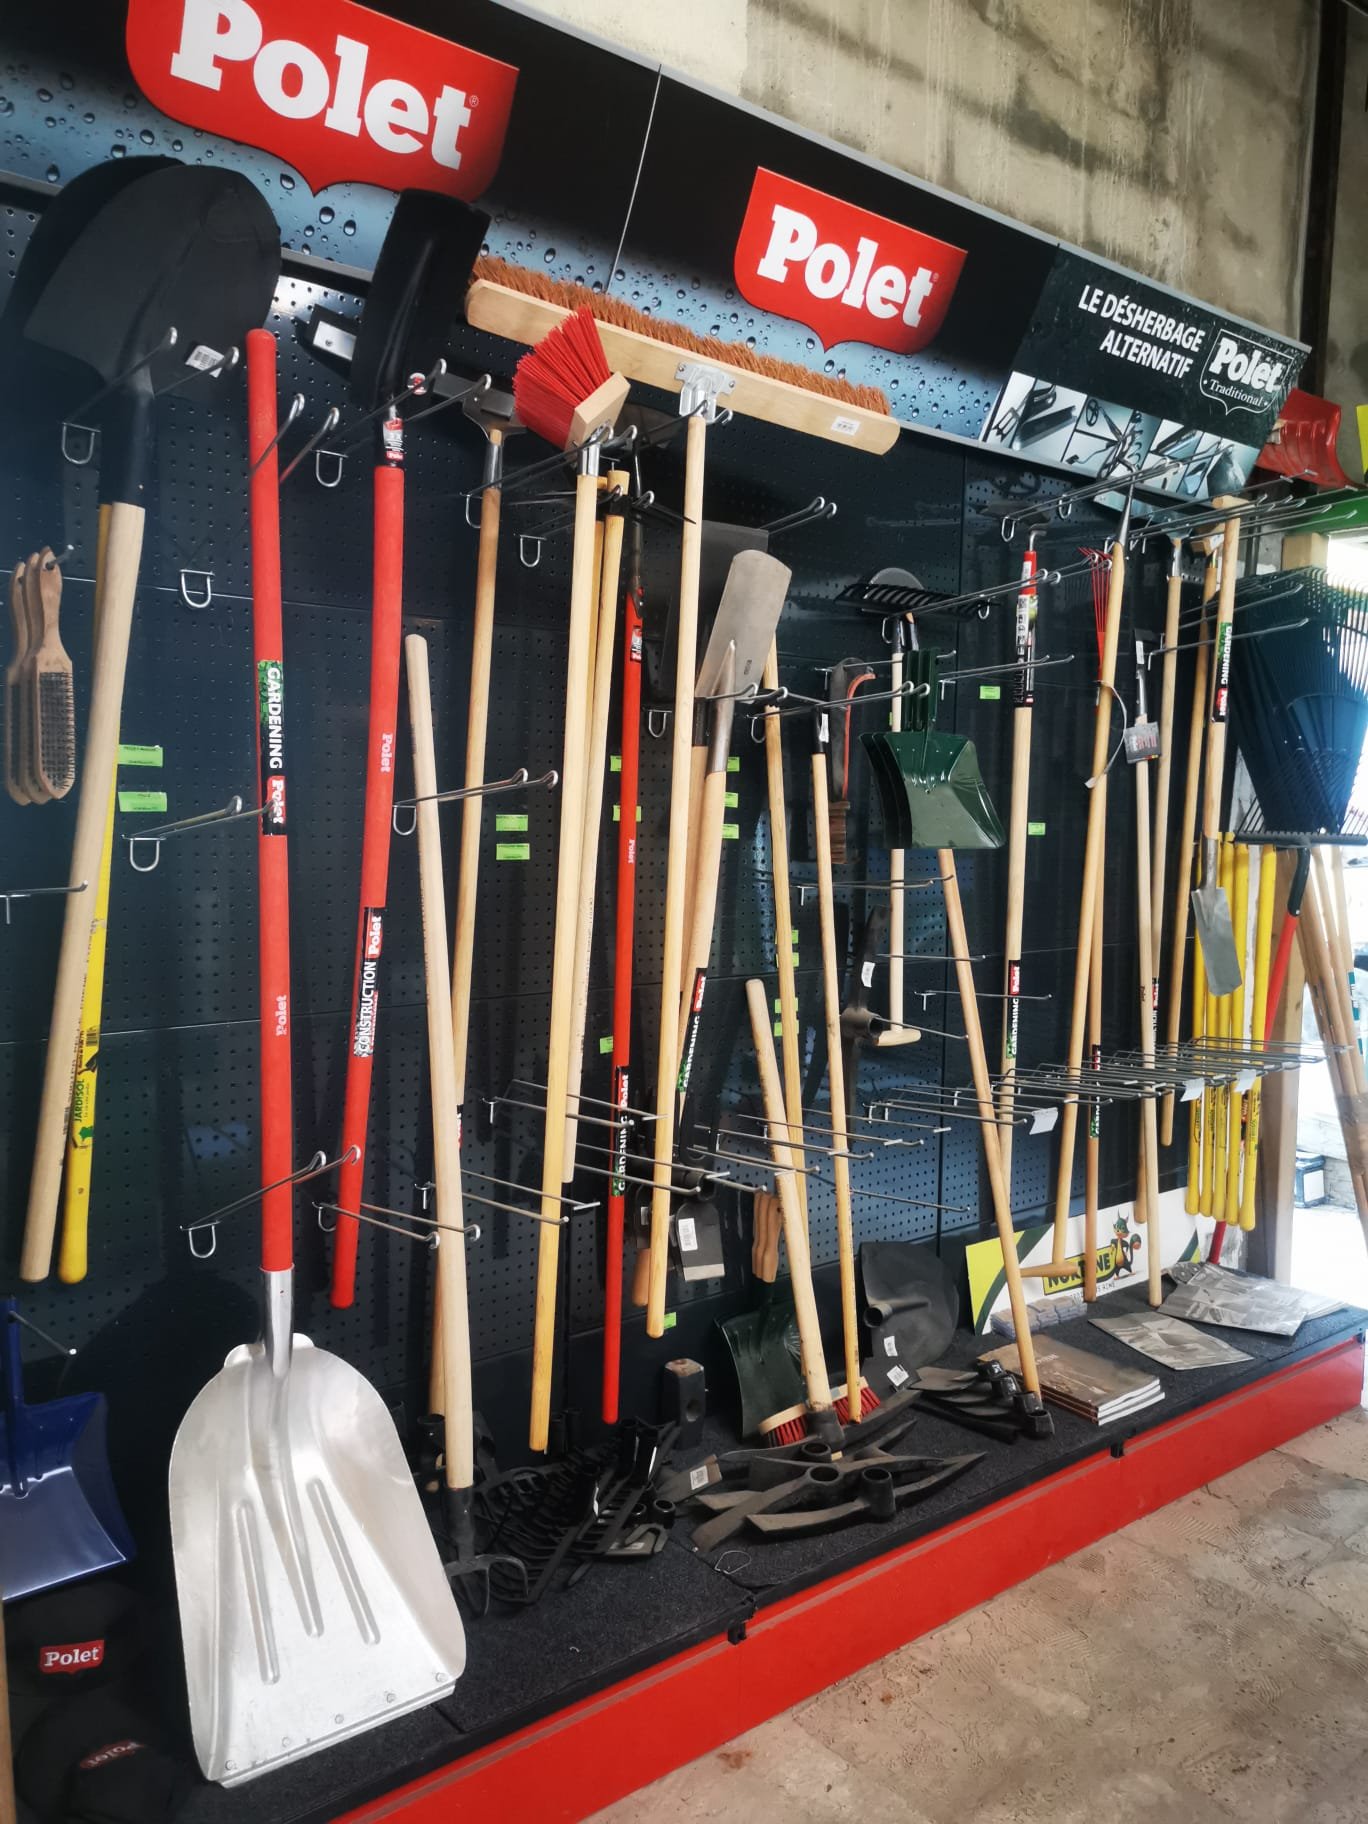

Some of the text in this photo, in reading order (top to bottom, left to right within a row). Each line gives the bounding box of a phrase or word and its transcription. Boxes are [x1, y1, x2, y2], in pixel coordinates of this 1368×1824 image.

[170, 0, 472, 171] Polet
[756, 203, 934, 328] Polet
[1078, 284, 1206, 353] LE DÉSHERBAGE
[1099, 329, 1194, 379] ALTERNATIF
[1208, 337, 1287, 393] Polet
[1208, 378, 1264, 407] Traditional
[1220, 625, 1233, 685] GARDENING
[267, 667, 285, 824] GARDENING Polet
[380, 732, 393, 773] Polet
[628, 839, 636, 864] Polet
[358, 961, 377, 1052] CONSTRUCTION
[368, 914, 382, 955] Polet
[275, 995, 288, 1036] Polet
[1011, 998, 1019, 1055] GARDENING
[683, 1015, 700, 1088] GARDENING
[74, 1079, 85, 1122] JARDISOL
[44, 1647, 99, 1667] Polet
